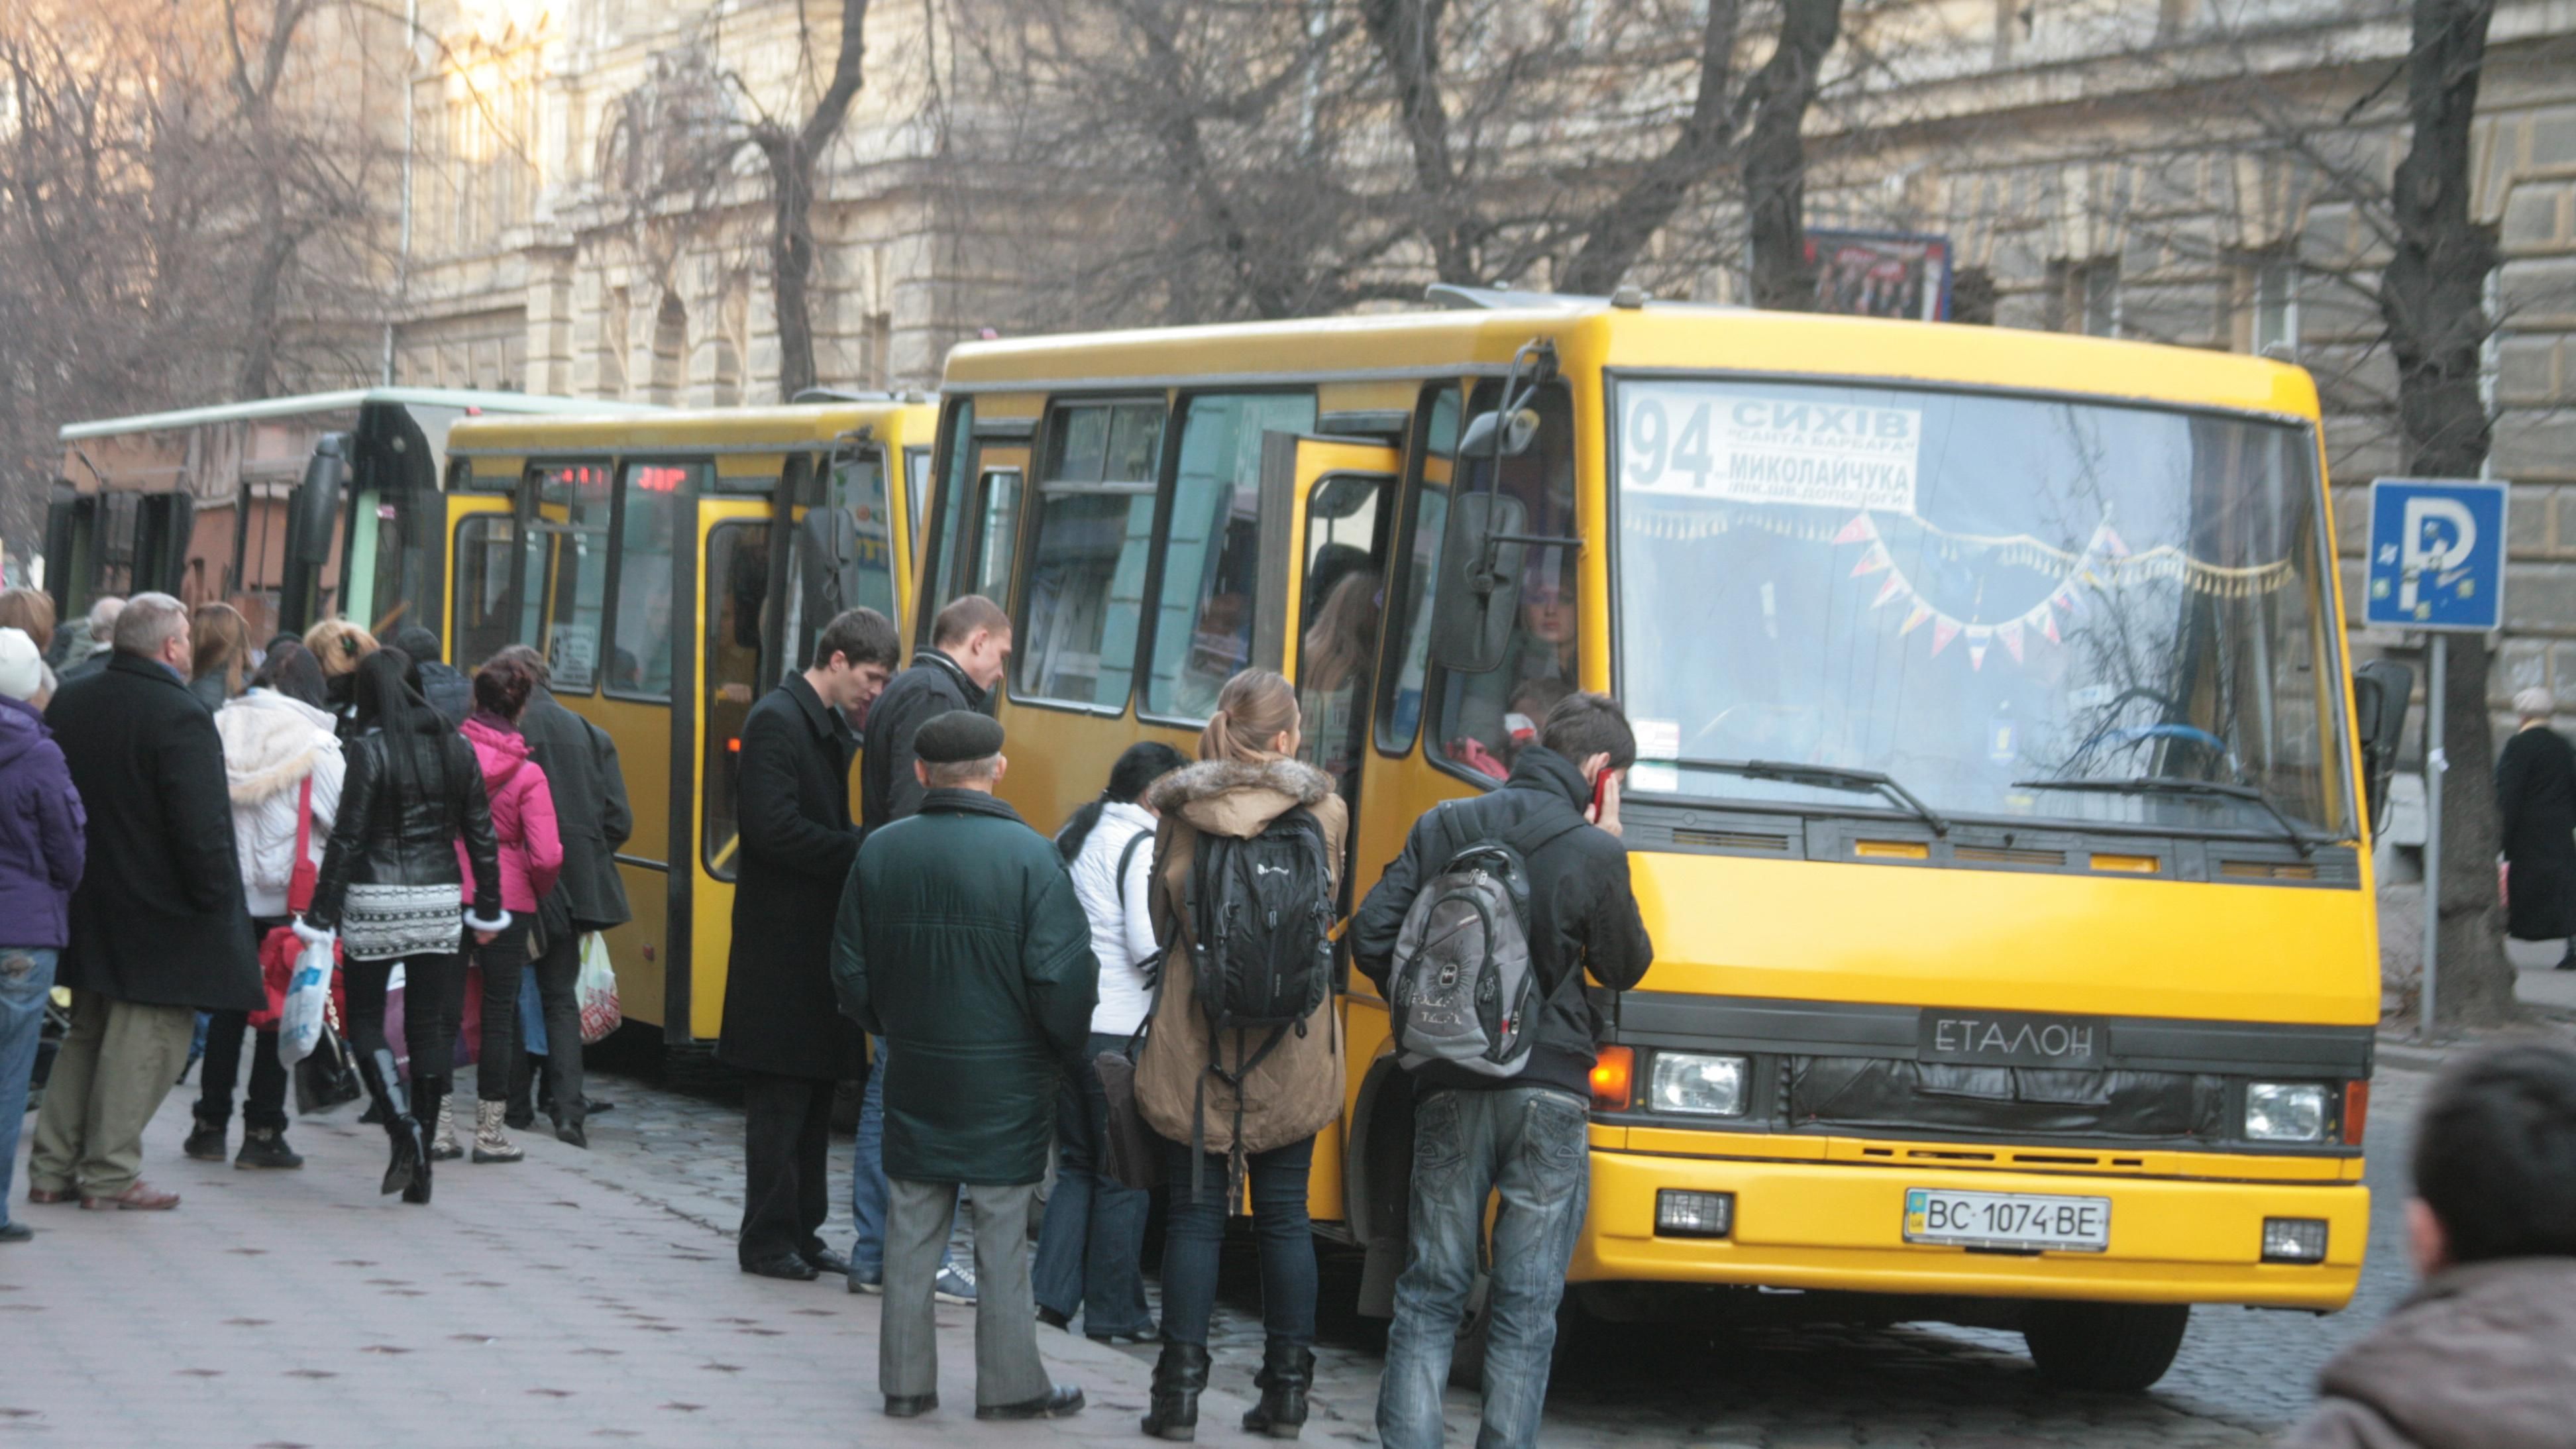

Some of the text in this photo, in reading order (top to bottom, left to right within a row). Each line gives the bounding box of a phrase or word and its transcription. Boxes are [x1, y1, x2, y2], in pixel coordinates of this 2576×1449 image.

[1731, 401, 1909, 439] СИХІВ
[1628, 398, 1712, 489] 94
[1728, 452, 1909, 492] МИКОЛАЙЧУКА
[2398, 497, 2477, 610] P
[1928, 1200, 1970, 1230] BC
[1983, 1203, 2047, 1234] 1074
[2056, 1206, 2098, 1236] BE
